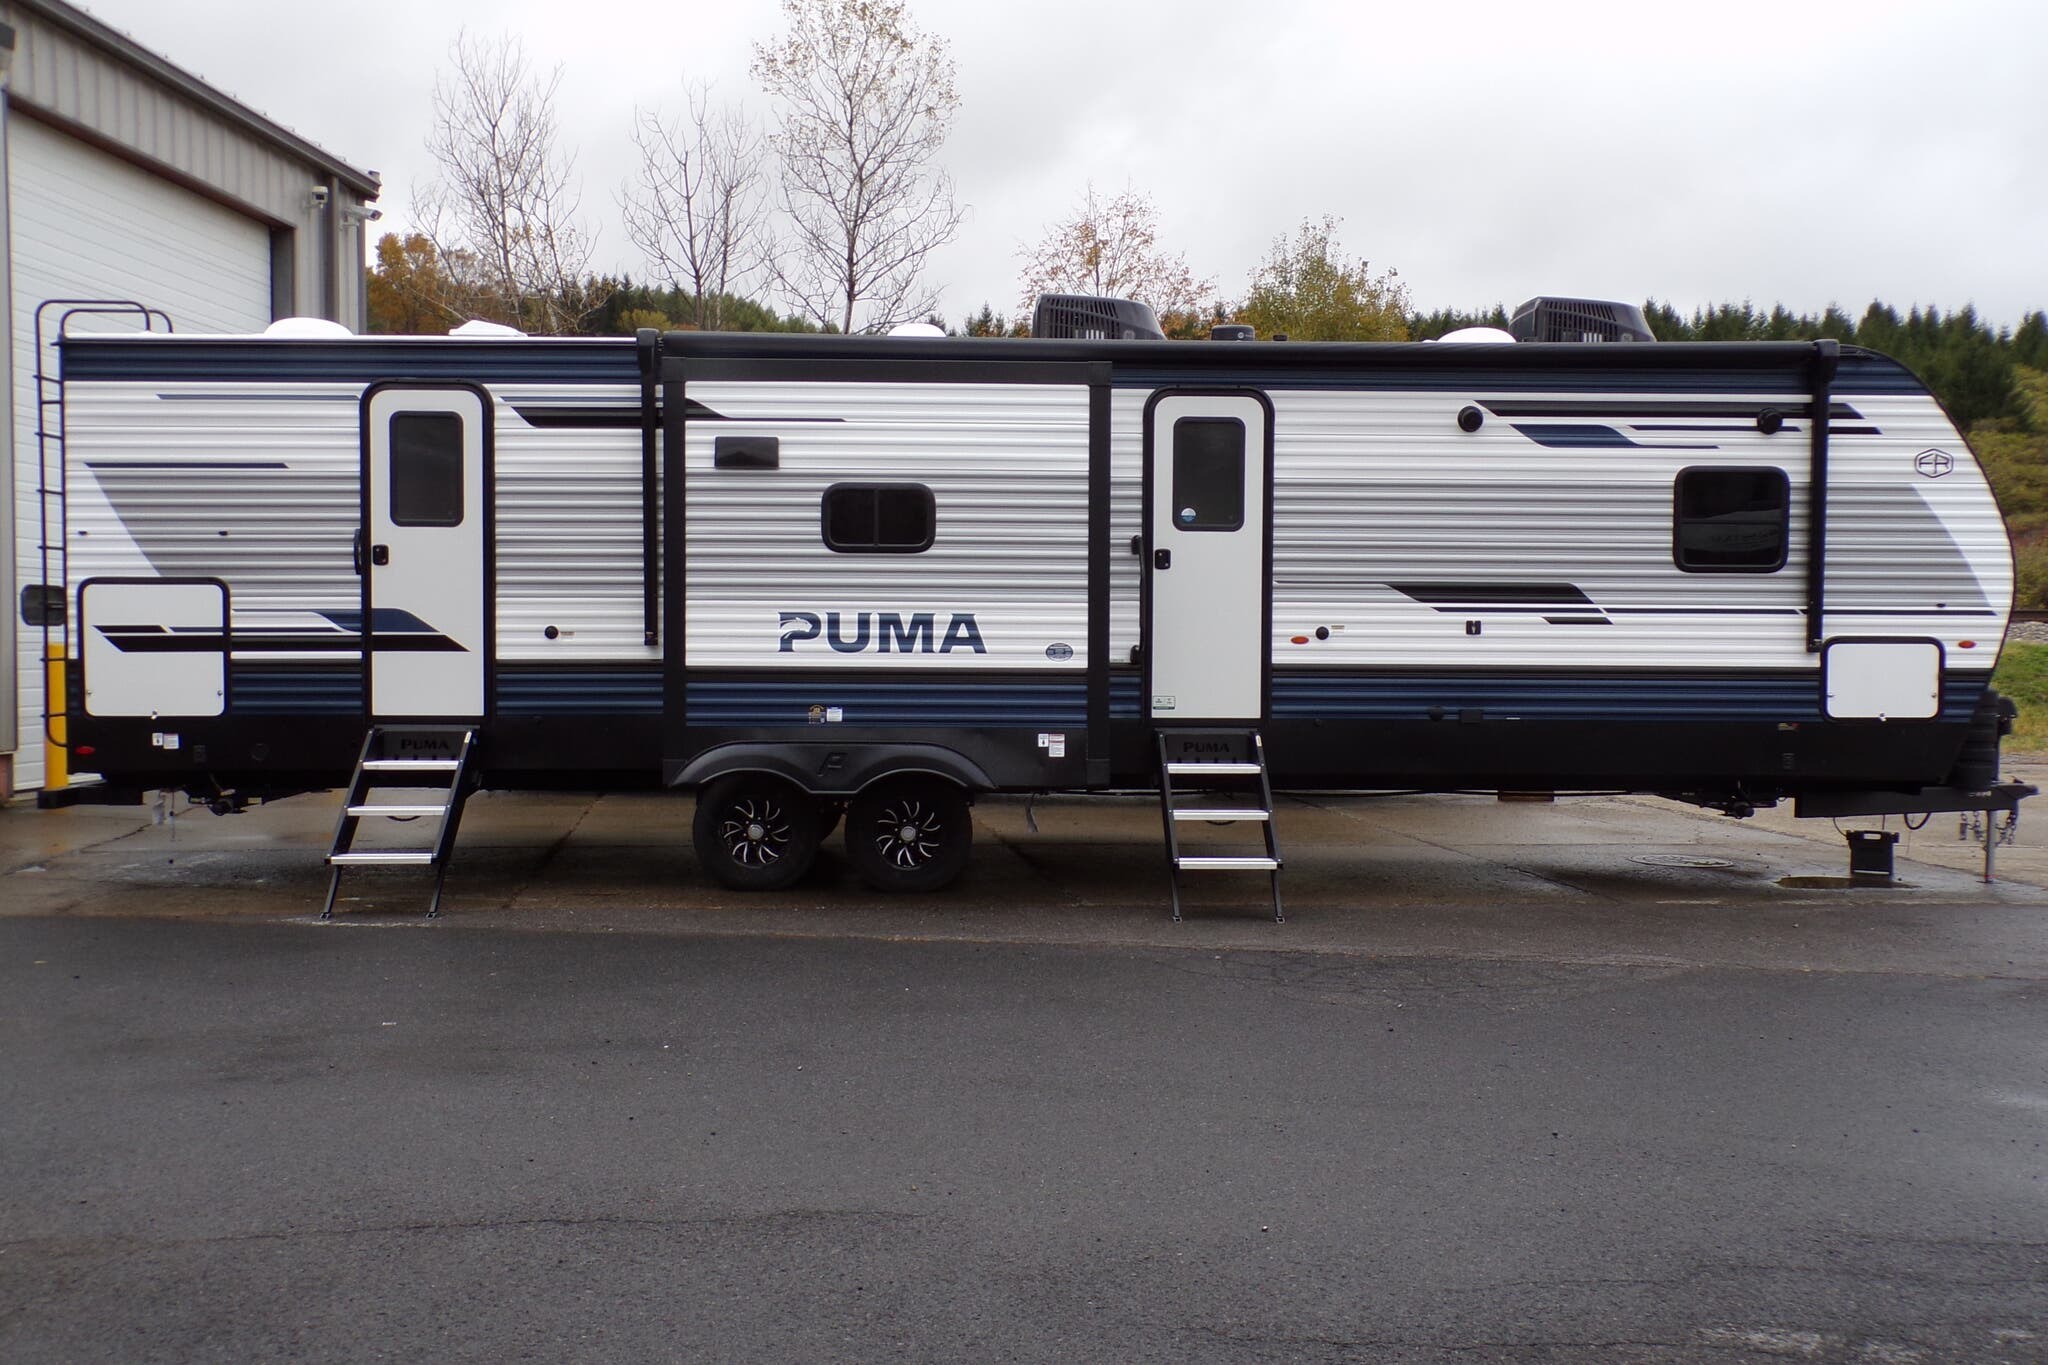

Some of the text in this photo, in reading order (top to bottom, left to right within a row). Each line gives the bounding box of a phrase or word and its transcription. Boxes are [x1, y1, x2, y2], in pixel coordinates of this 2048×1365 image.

[778, 611, 988, 654] PUMA
[400, 738, 450, 751] PUMA
[1183, 741, 1231, 753] PUMA
